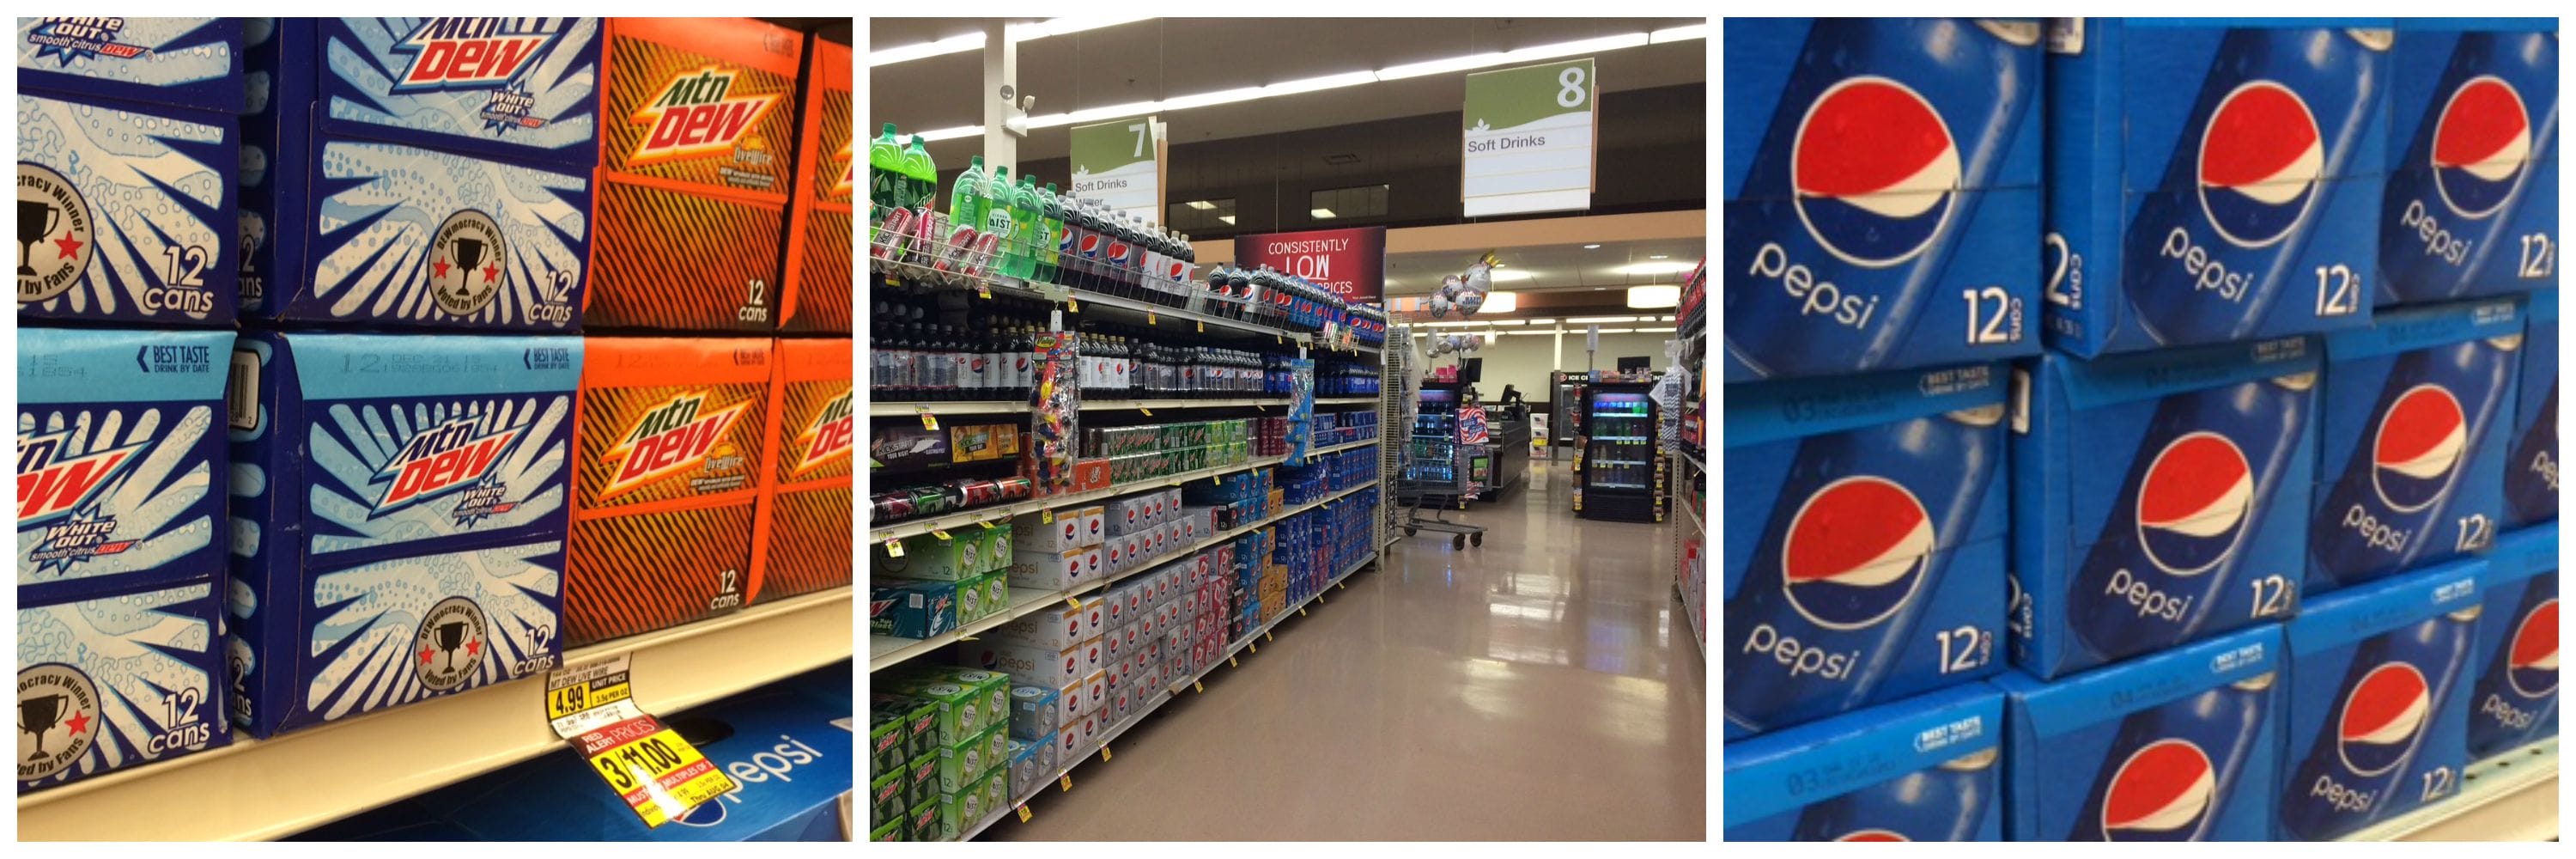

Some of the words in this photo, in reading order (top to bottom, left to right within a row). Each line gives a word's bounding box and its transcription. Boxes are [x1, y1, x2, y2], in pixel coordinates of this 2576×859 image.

[29, 34, 70, 46] smooth
[72, 41, 101, 52] citrus
[56, 22, 102, 40] OUT
[1557, 66, 1586, 108] 8
[1128, 123, 1146, 158] 7
[1467, 138, 1497, 153] Soft
[1501, 135, 1546, 149] Drinks
[1075, 181, 1094, 192] Soft
[1097, 179, 1127, 190] Drinks
[52, 185, 84, 233] Winner
[1075, 198, 1104, 207] Wer
[484, 228, 502, 262] Winner
[1268, 238, 1349, 255] CONSISTENTLY
[2400, 198, 2472, 267] pepsi
[163, 245, 208, 287] 12
[2160, 226, 2255, 303] pepsi
[2517, 232, 2547, 279] 12
[25, 280, 42, 295] by
[45, 262, 76, 289] Fans
[545, 270, 574, 303] 12
[748, 279, 764, 305] 12
[1749, 241, 1880, 331] pepsi
[2314, 264, 2351, 317] 12
[143, 286, 214, 314] cans
[437, 285, 459, 310] Voted
[460, 299, 471, 311] by
[472, 284, 493, 307] Fans
[529, 302, 574, 324] cans
[738, 305, 767, 322] cans
[1963, 286, 2010, 344] 12
[2009, 297, 2023, 342] cans
[153, 345, 176, 364] BEST
[179, 345, 210, 364] TASTE
[154, 364, 179, 374] DRINK
[180, 364, 190, 373] BY
[191, 363, 210, 373] DATE
[533, 348, 549, 362] BEST
[550, 347, 570, 362] TASTE
[55, 533, 97, 549] OUT
[2342, 503, 2411, 553] pepsi
[2455, 513, 2488, 552] 12
[31, 548, 68, 561] smooth
[70, 545, 95, 557] citrus
[1012, 561, 1038, 576] epsi
[720, 569, 737, 594] 12
[2105, 568, 2194, 622] pepsi
[2250, 573, 2284, 618] 12
[710, 592, 739, 610] cans
[465, 606, 483, 637] Winner
[526, 624, 550, 657] 12
[1742, 623, 1860, 680] pepsi
[1935, 624, 1978, 674] 12
[1977, 631, 1992, 666] cans
[423, 668, 445, 686] Voted
[446, 674, 458, 686] by
[458, 658, 477, 679] Fans
[513, 653, 555, 677] cans
[999, 656, 1036, 671] pepsi
[63, 675, 91, 710] Winner
[562, 675, 577, 686] DEW
[592, 677, 608, 690] UNIT
[608, 673, 626, 685] PRICE
[609, 690, 619, 699] PER
[162, 686, 200, 730] 12
[556, 685, 584, 715] 4.99
[2481, 693, 2538, 729] pepsi
[148, 720, 211, 754] cans
[580, 733, 604, 744] RED
[585, 738, 615, 754] ALERT
[611, 720, 656, 741] PRICES
[38, 758, 55, 773] by
[56, 738, 84, 765] Fans
[2310, 775, 2379, 812] pepsi
[2420, 766, 2449, 802] 12
